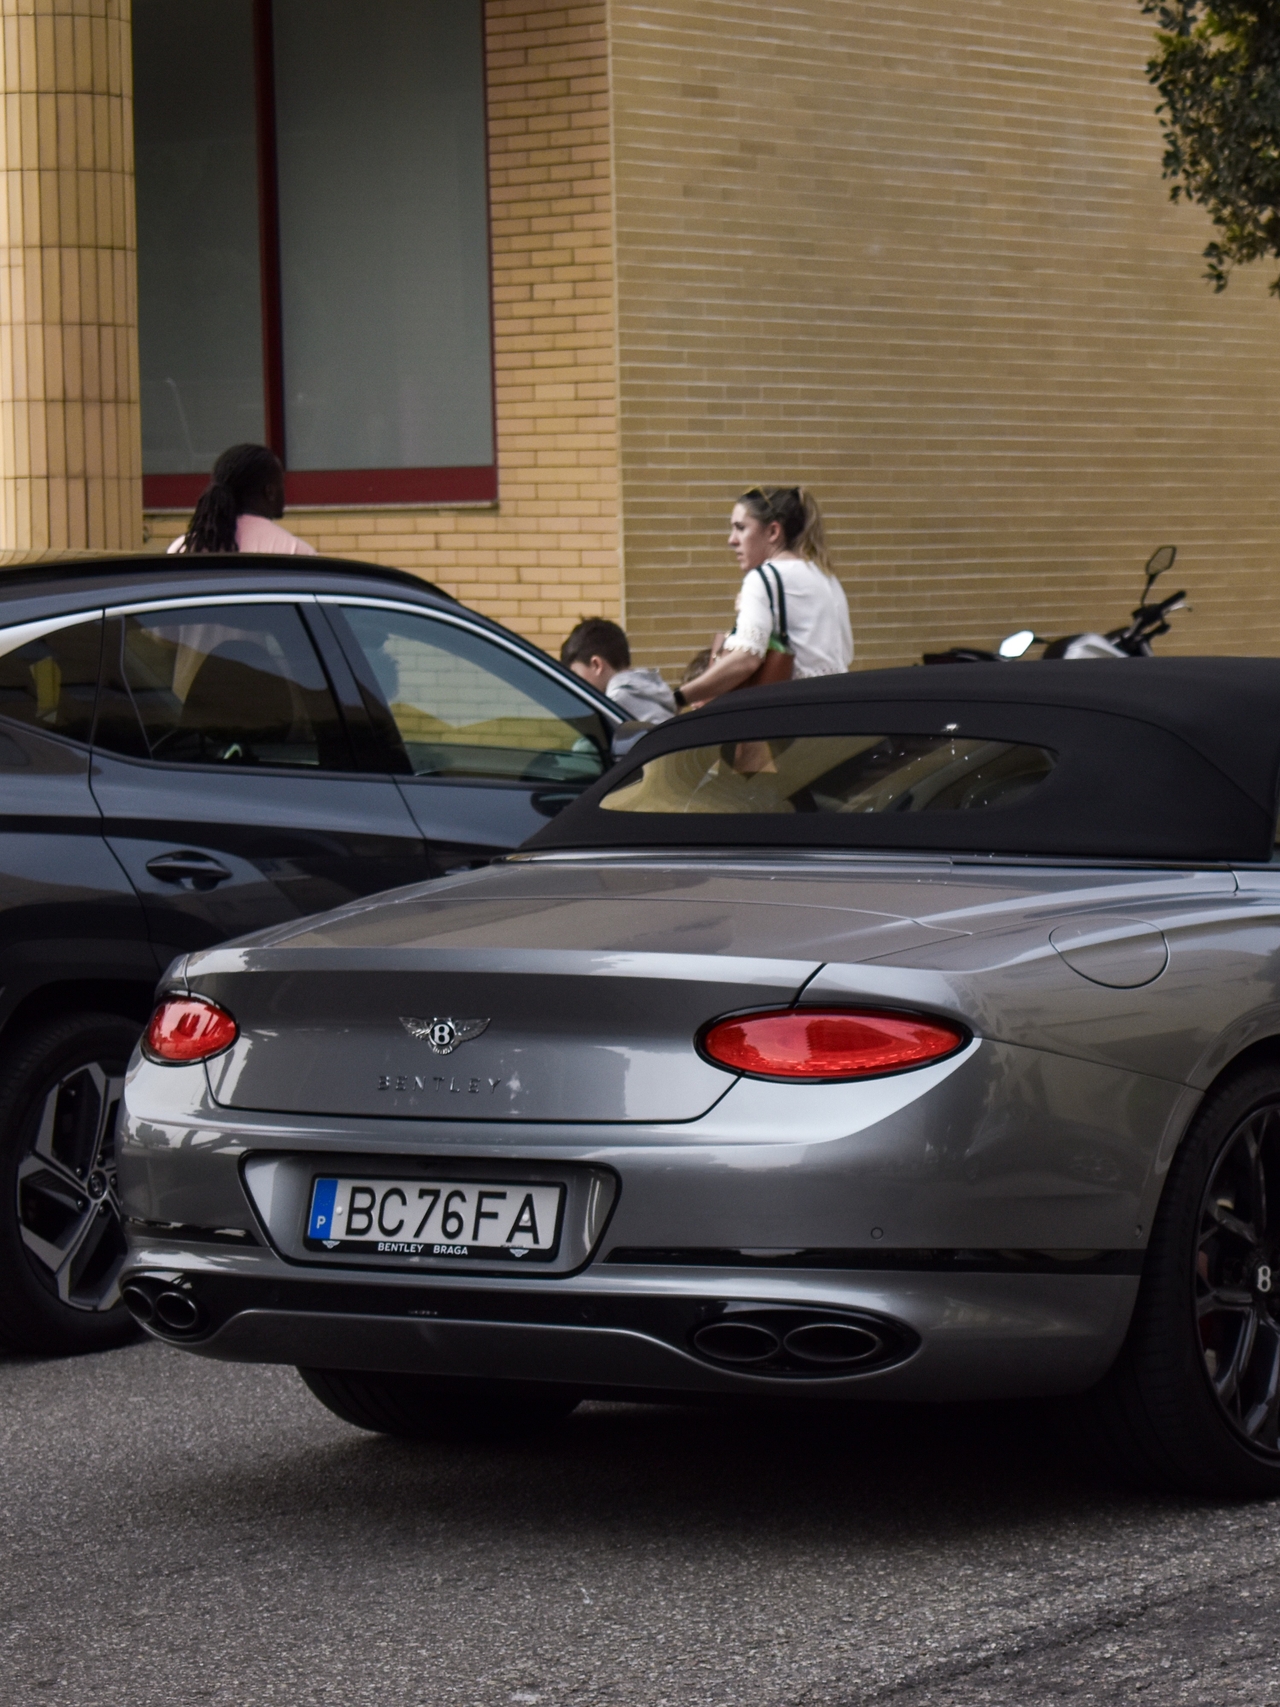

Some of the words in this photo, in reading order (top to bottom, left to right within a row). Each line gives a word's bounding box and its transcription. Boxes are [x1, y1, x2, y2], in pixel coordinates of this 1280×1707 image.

[377, 1075, 502, 1094] BENTLEY
[316, 1215, 326, 1229] P
[345, 1186, 540, 1245] BC76FA
[377, 1242, 424, 1254] BENTLEY
[432, 1244, 469, 1256] BRAGA
